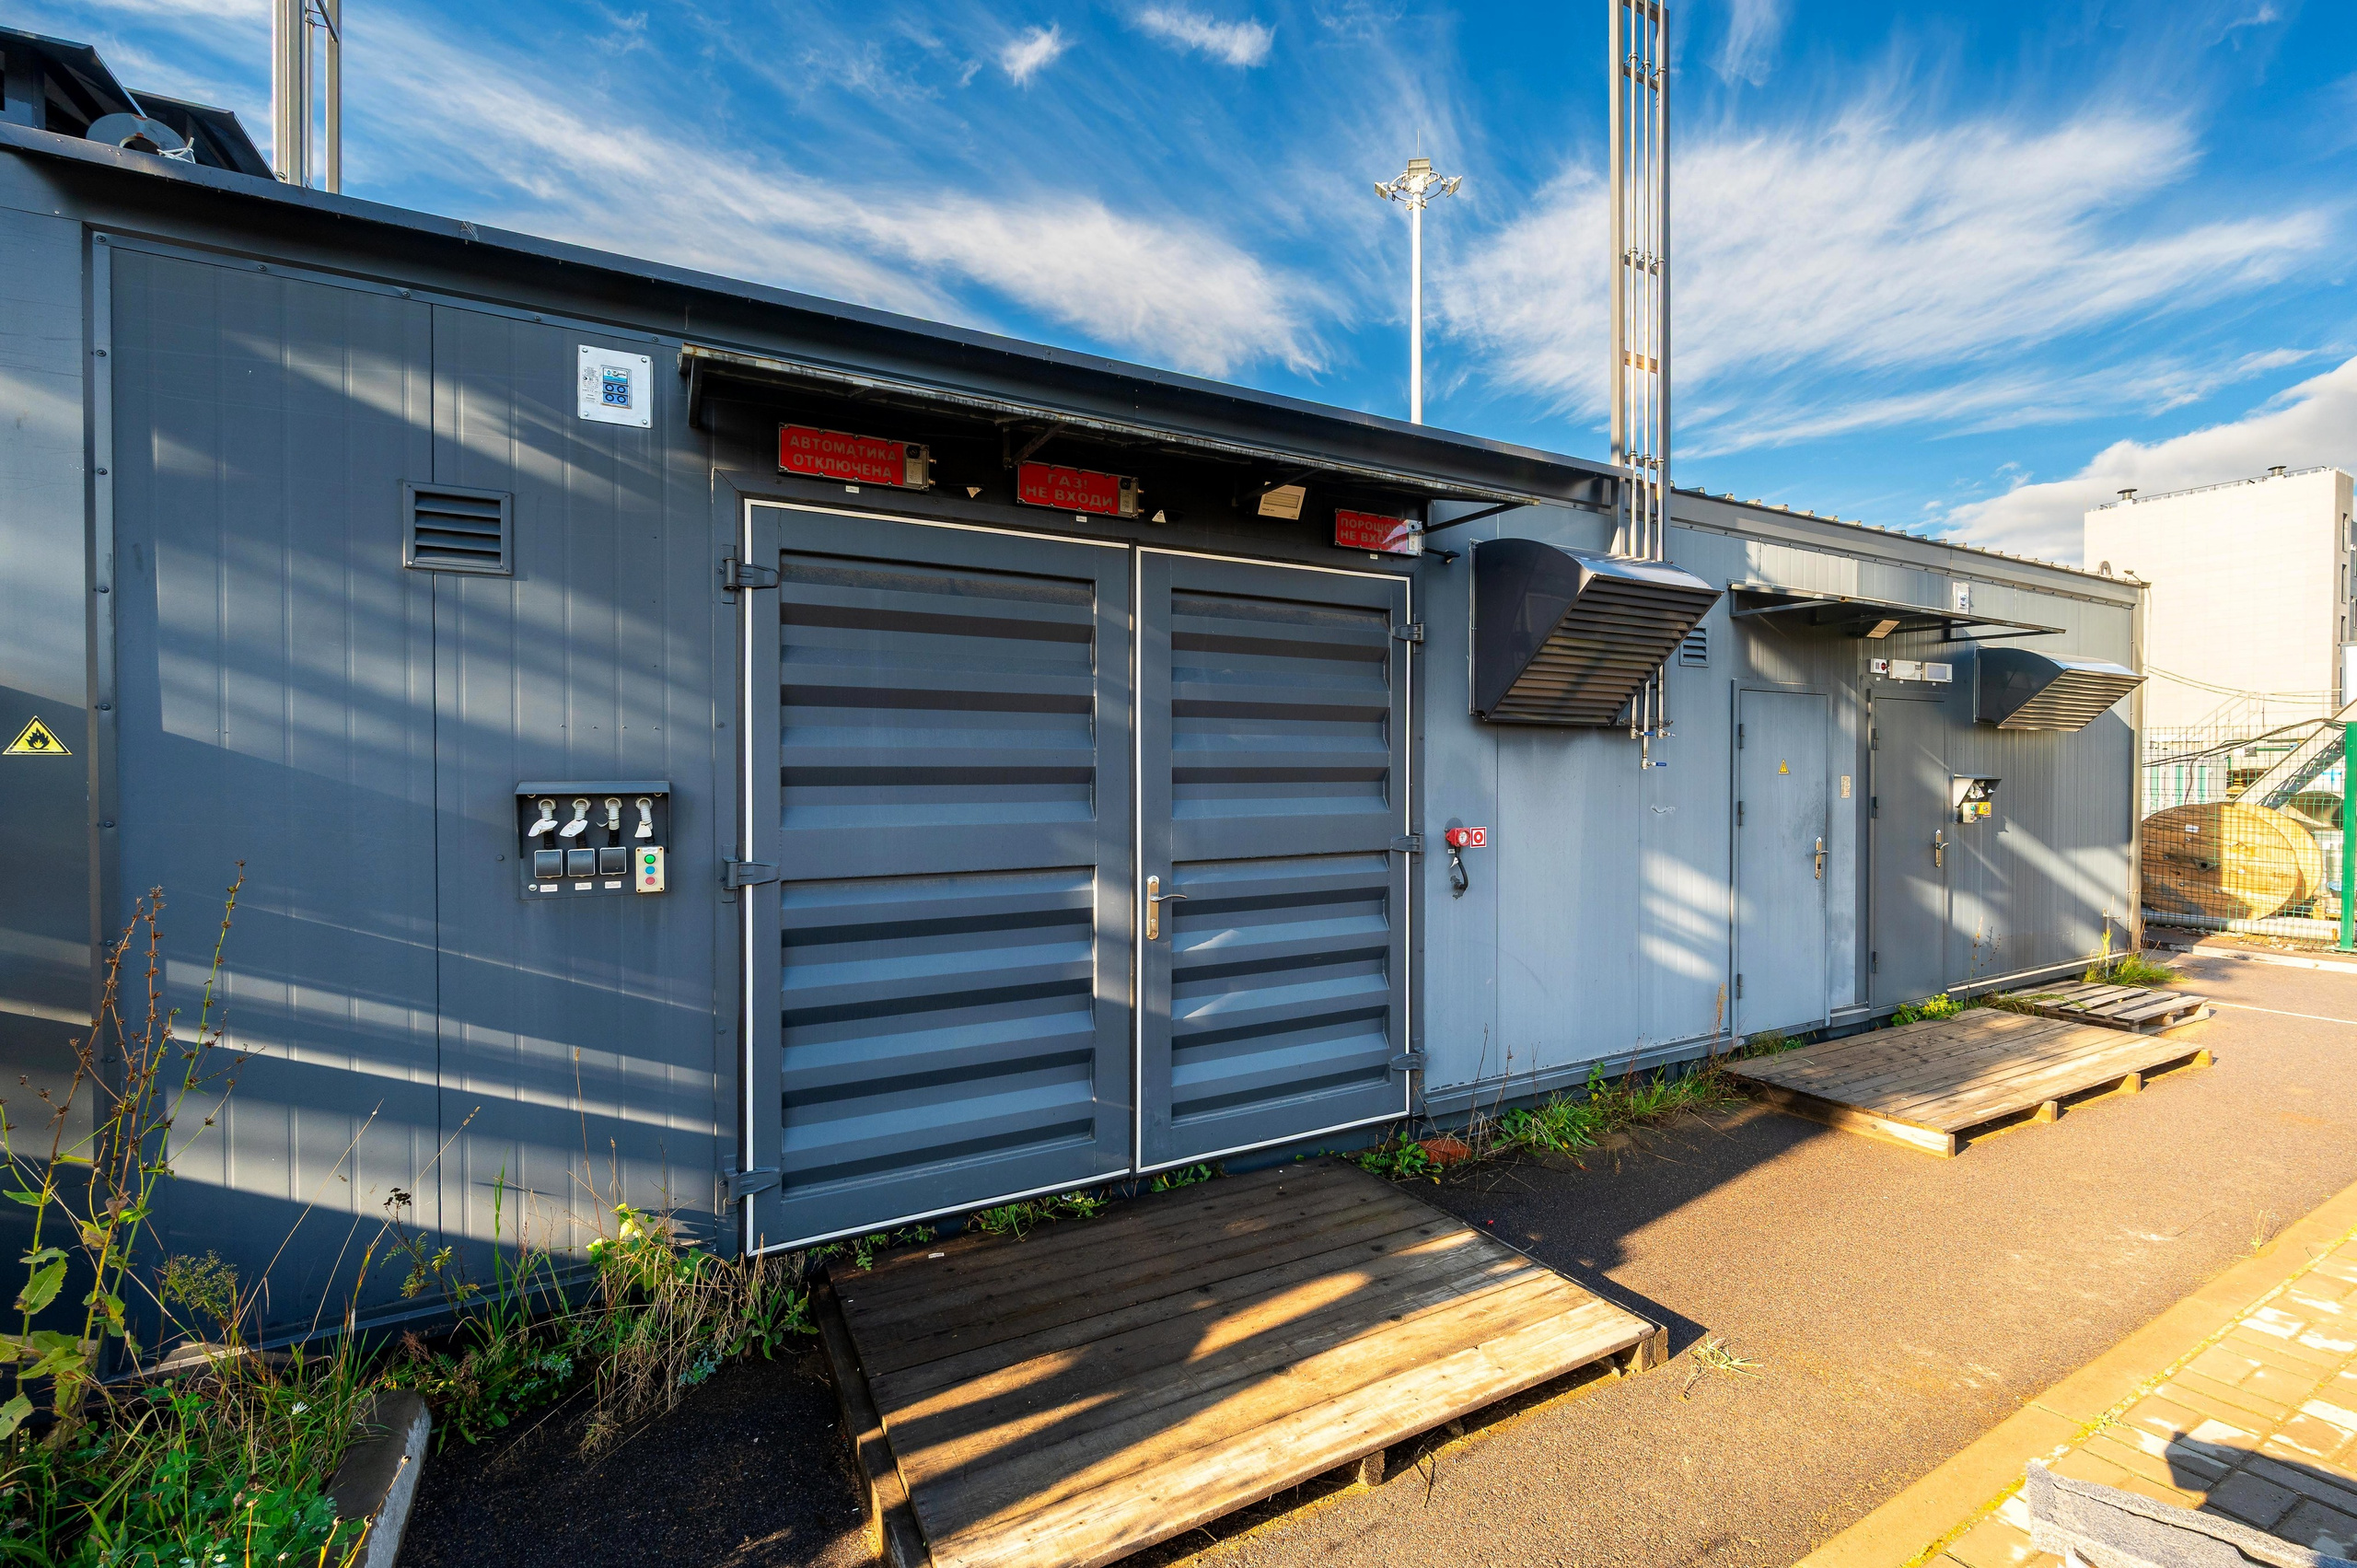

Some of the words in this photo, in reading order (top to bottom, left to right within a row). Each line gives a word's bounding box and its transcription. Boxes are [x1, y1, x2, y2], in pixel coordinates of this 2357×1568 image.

[789, 434, 897, 461] АВТОМАТИКА
[793, 453, 891, 479] ОТКЛЮЧЕНА
[1047, 472, 1088, 491] ГАЗ!
[1026, 483, 1048, 499] НЕ
[1054, 488, 1112, 508] ВХОДИ
[1341, 517, 1399, 535] ПОРОШО
[1341, 529, 1356, 541] НЕ
